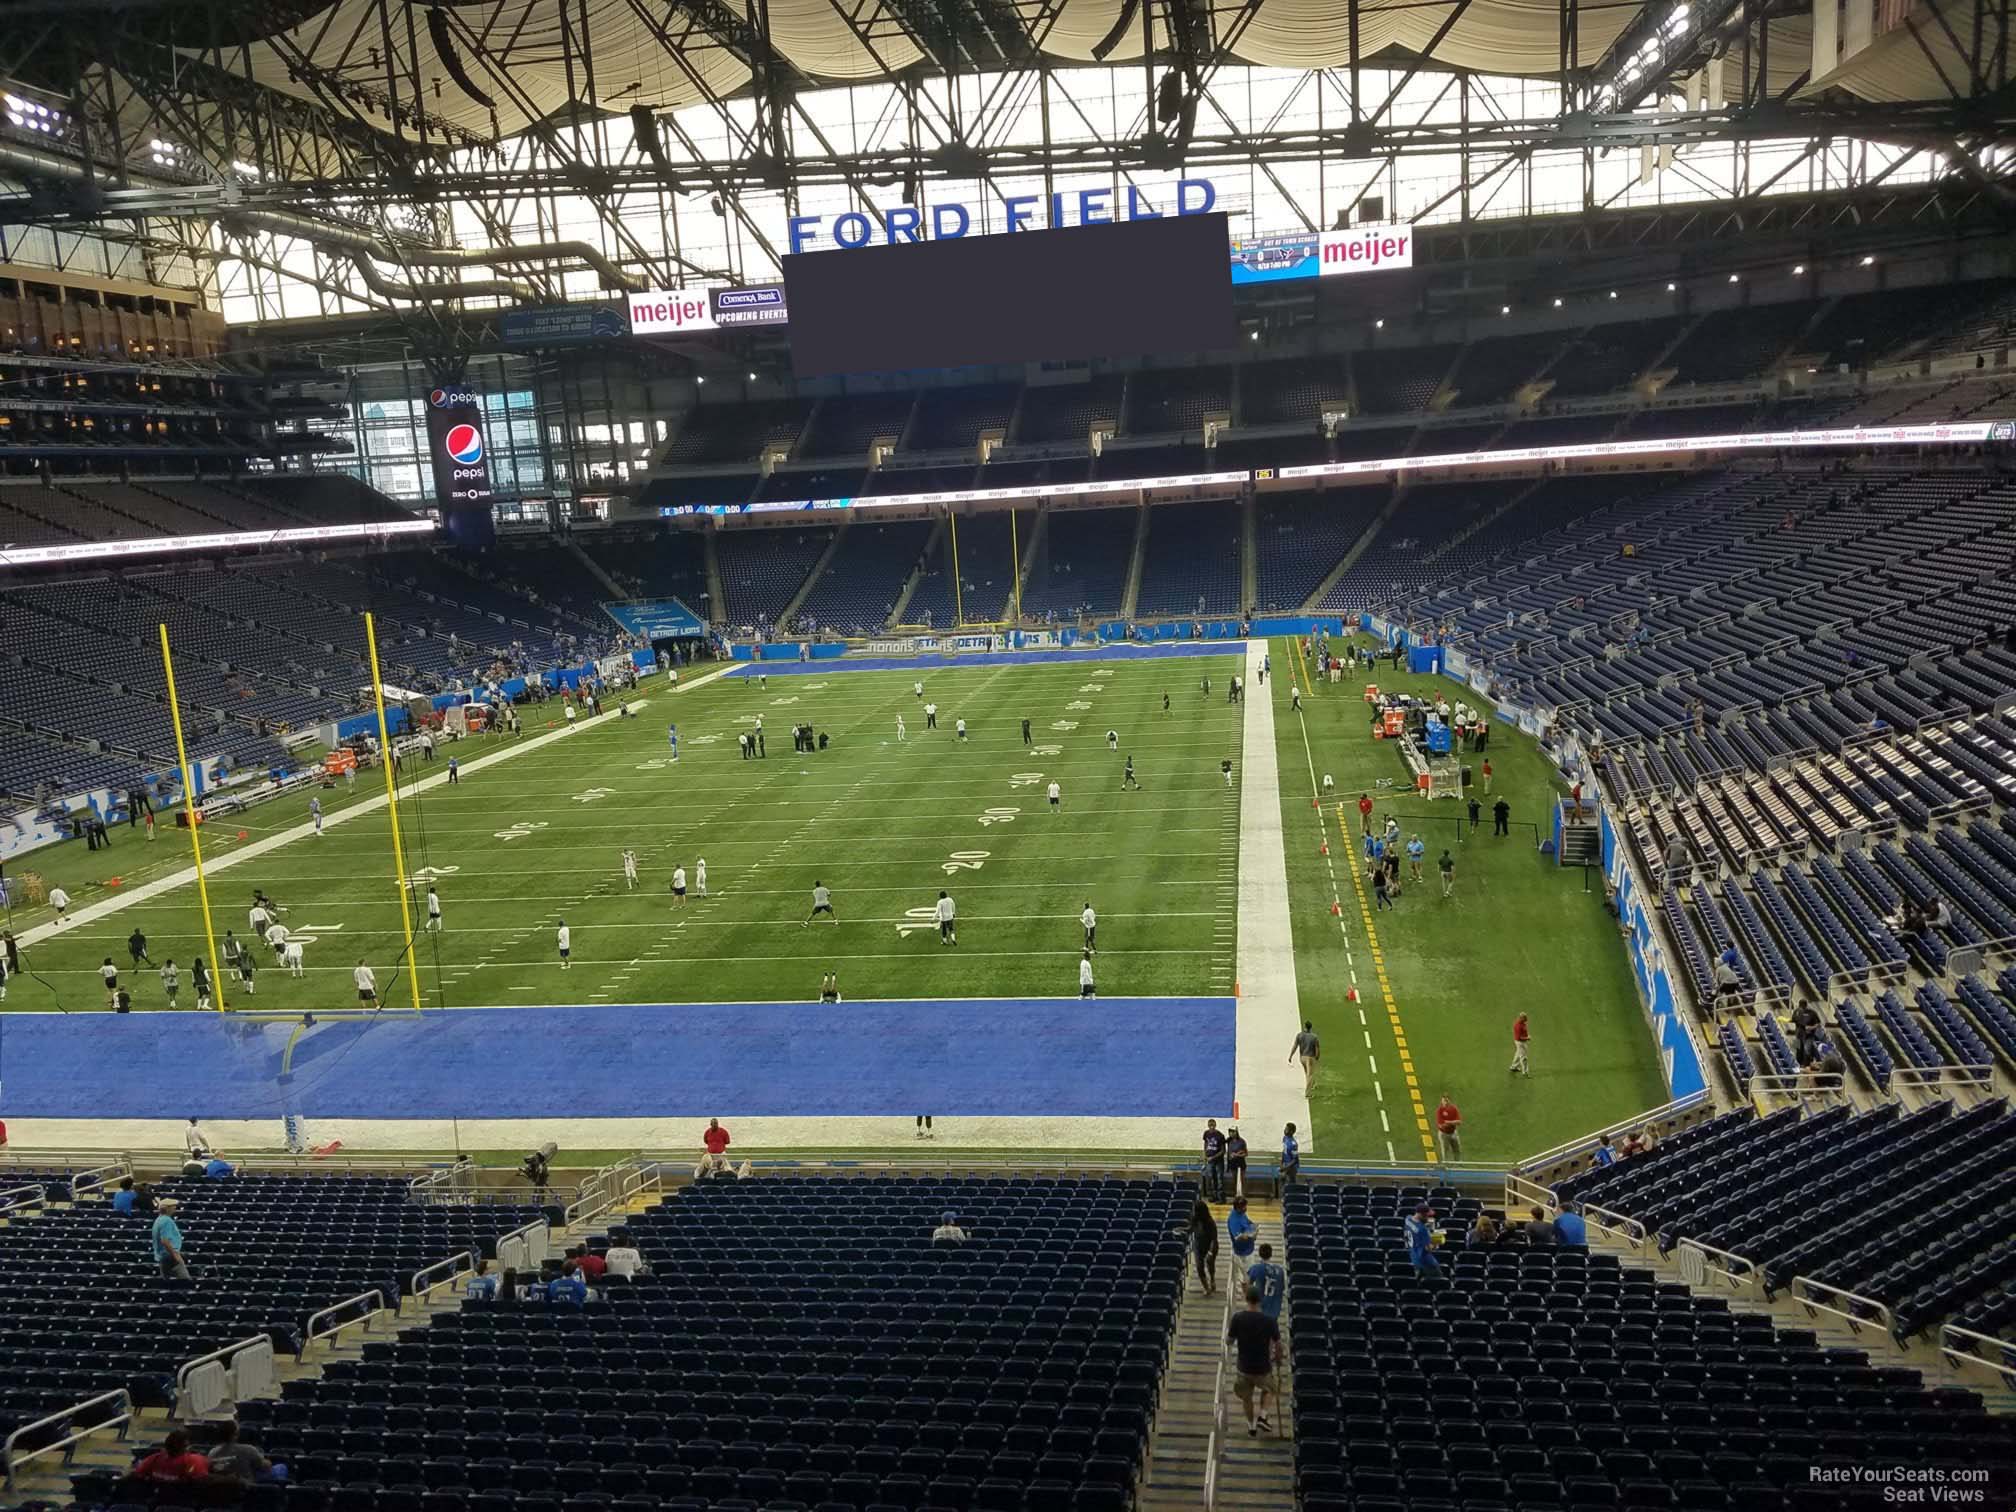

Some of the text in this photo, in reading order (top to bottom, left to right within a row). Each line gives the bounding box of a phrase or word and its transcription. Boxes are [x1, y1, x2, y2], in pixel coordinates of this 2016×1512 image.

[788, 179, 1217, 254] FORD FIELD
[1324, 232, 1408, 265] meijer
[758, 291, 776, 301] Bank
[632, 296, 705, 326] meijer
[715, 309, 788, 323] UPCOMING EVENTS
[453, 466, 484, 480] pepsi
[680, 626, 701, 635] LIONS
[978, 807, 1021, 823] 30
[494, 822, 549, 838] 30
[941, 850, 992, 870] 20
[395, 865, 460, 885] 20
[896, 907, 940, 931] 10
